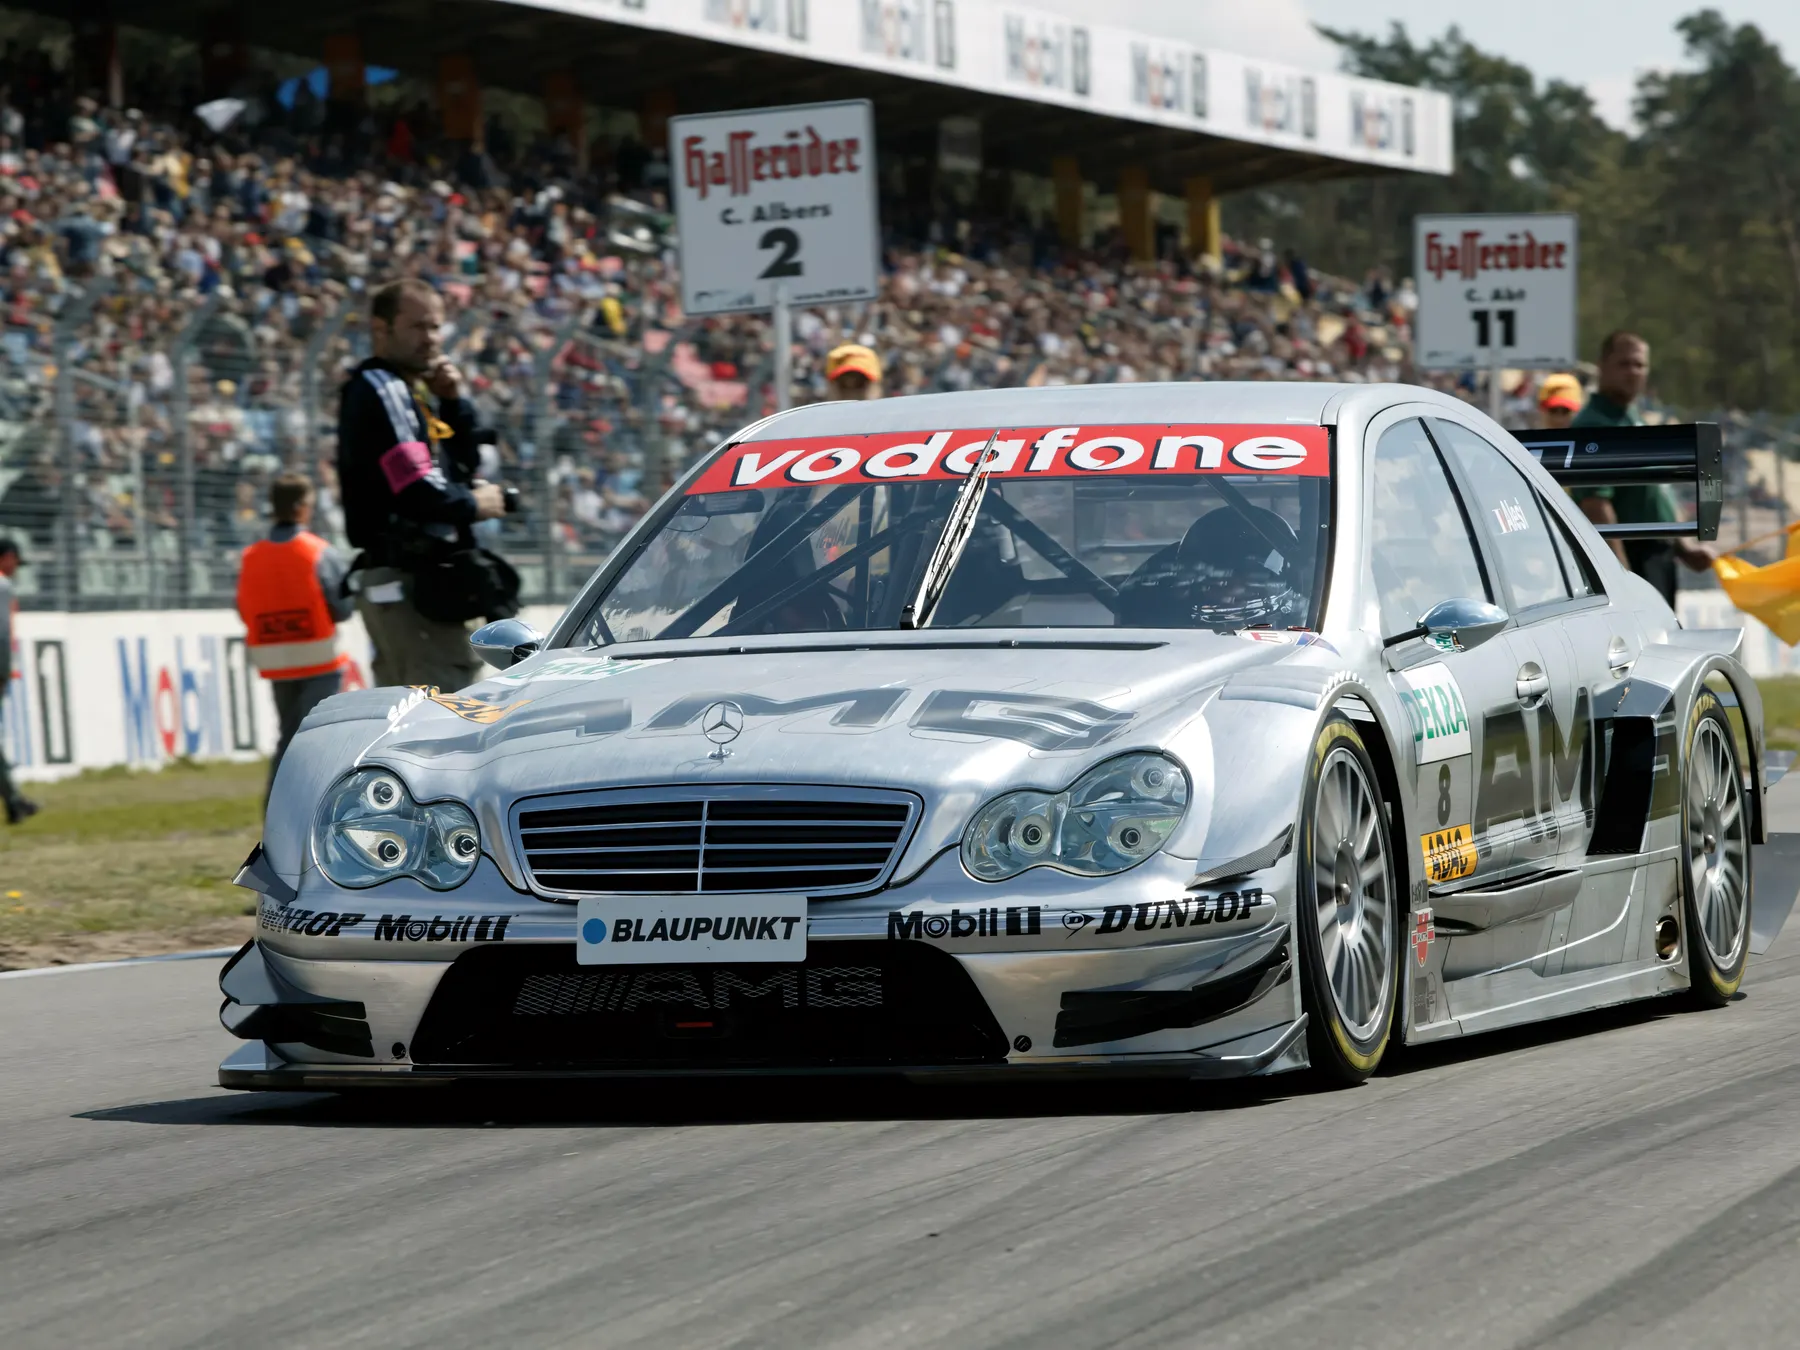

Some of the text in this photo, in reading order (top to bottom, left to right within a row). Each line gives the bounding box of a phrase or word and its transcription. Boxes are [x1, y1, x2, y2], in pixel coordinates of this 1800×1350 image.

[720, 202, 832, 225] C. Albers
[757, 228, 804, 280] 2
[1471, 309, 1516, 348] 11
[734, 427, 1309, 486] vodafone
[116, 636, 223, 763] Mobil
[1400, 682, 1469, 743] DEKRA
[1437, 763, 1452, 827] 8
[374, 914, 473, 941] Mobil
[611, 916, 801, 943] BLAUPUNKT
[887, 908, 998, 940] Mobil
[1095, 887, 1263, 935] DUNLOP
